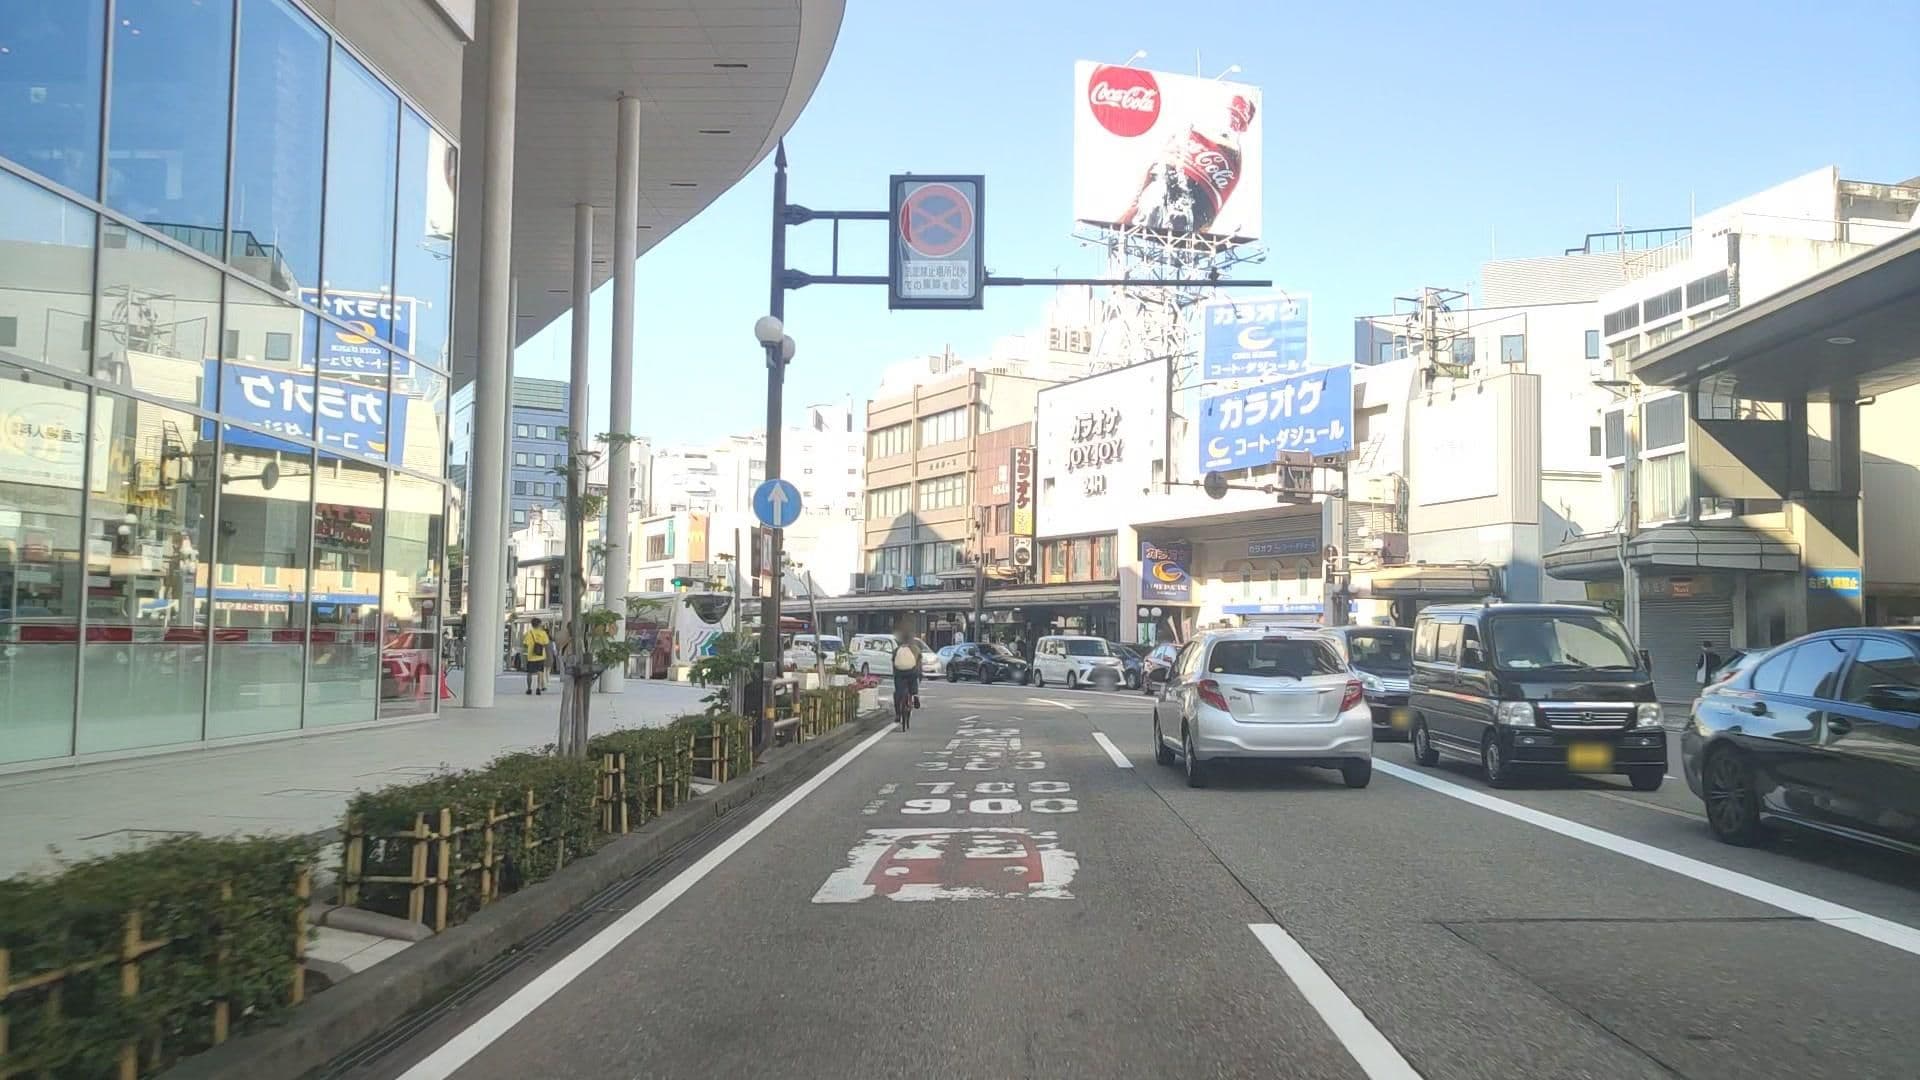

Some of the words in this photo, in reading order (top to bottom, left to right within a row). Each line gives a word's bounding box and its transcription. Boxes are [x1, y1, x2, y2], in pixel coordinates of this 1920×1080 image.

[1091, 82, 1158, 112] Coca-Cola
[1213, 302, 1300, 325] カラオケ
[1219, 379, 1323, 430] カラオケ
[1072, 407, 1122, 442] カラオケ
[1234, 420, 1345, 455] コート・ダジュール
[1065, 439, 1123, 473] JOYJOY
[1016, 449, 1031, 509] カラオケ
